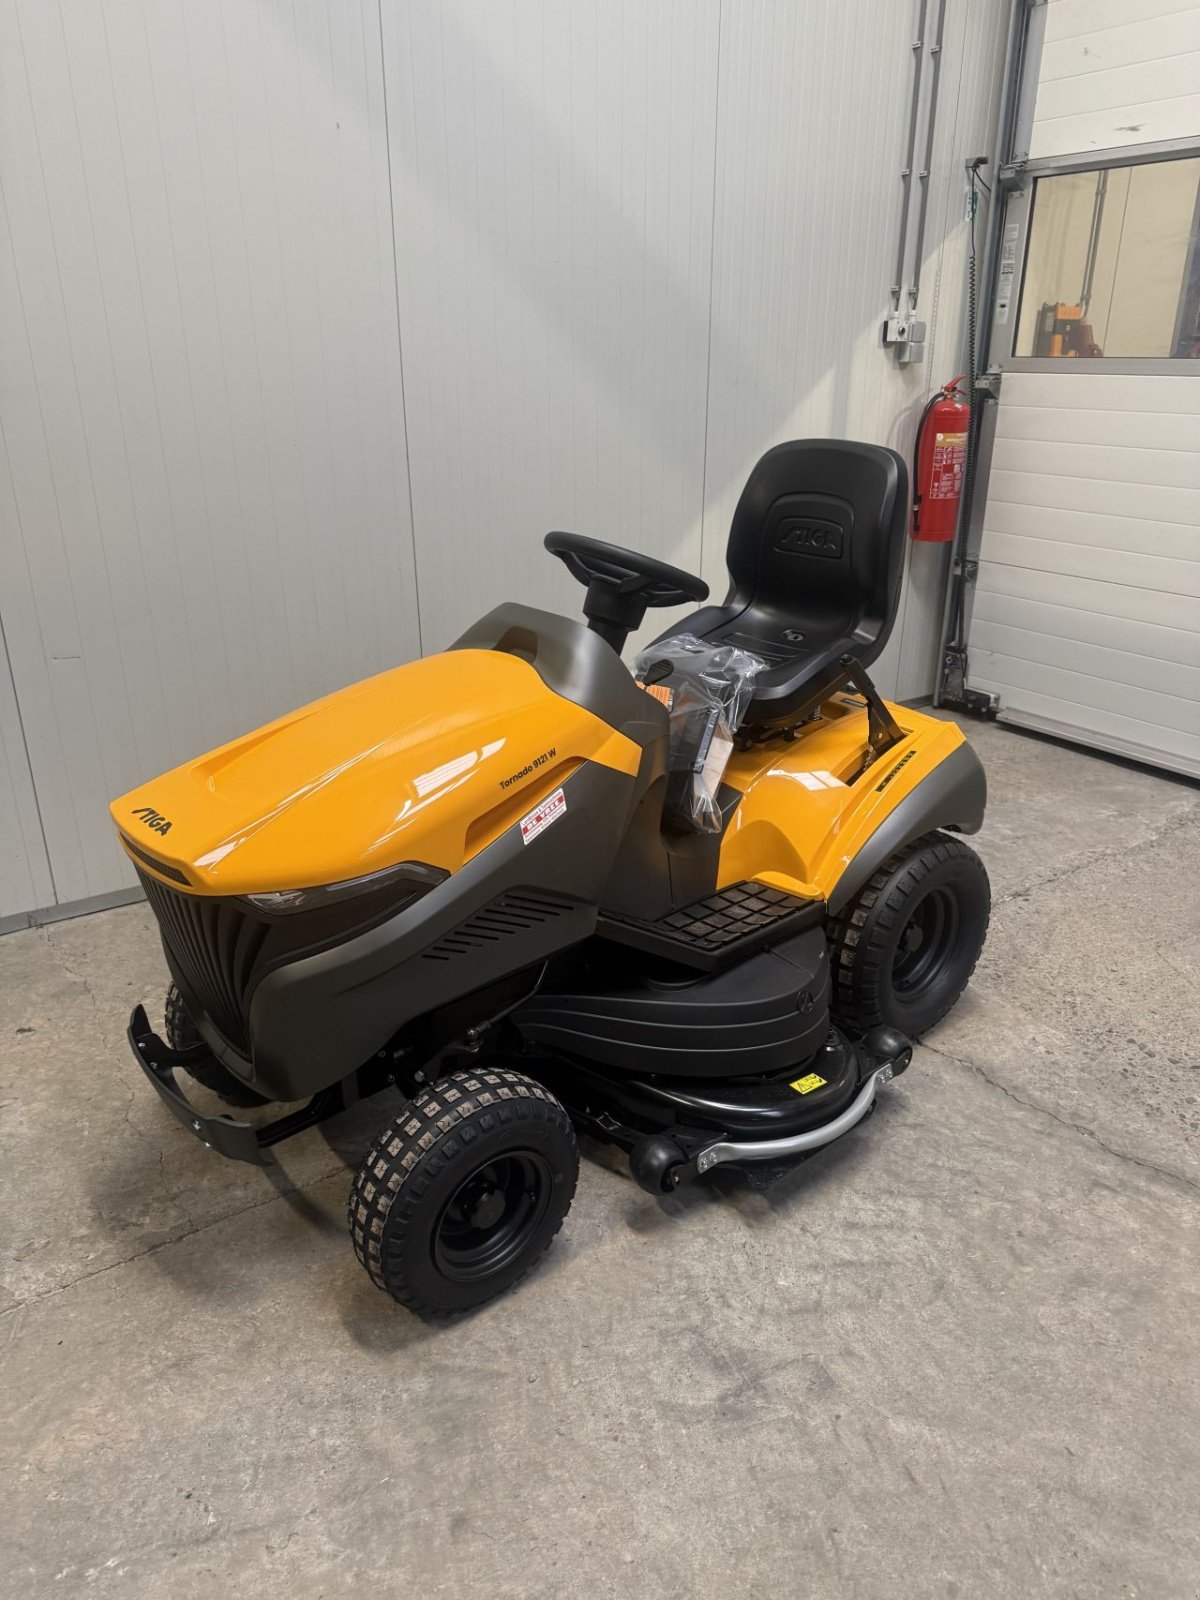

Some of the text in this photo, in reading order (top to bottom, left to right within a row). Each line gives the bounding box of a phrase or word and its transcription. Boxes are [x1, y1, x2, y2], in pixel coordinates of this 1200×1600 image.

[499, 748, 556, 790] Tornado 9121 W
[131, 807, 173, 836] STIGA
